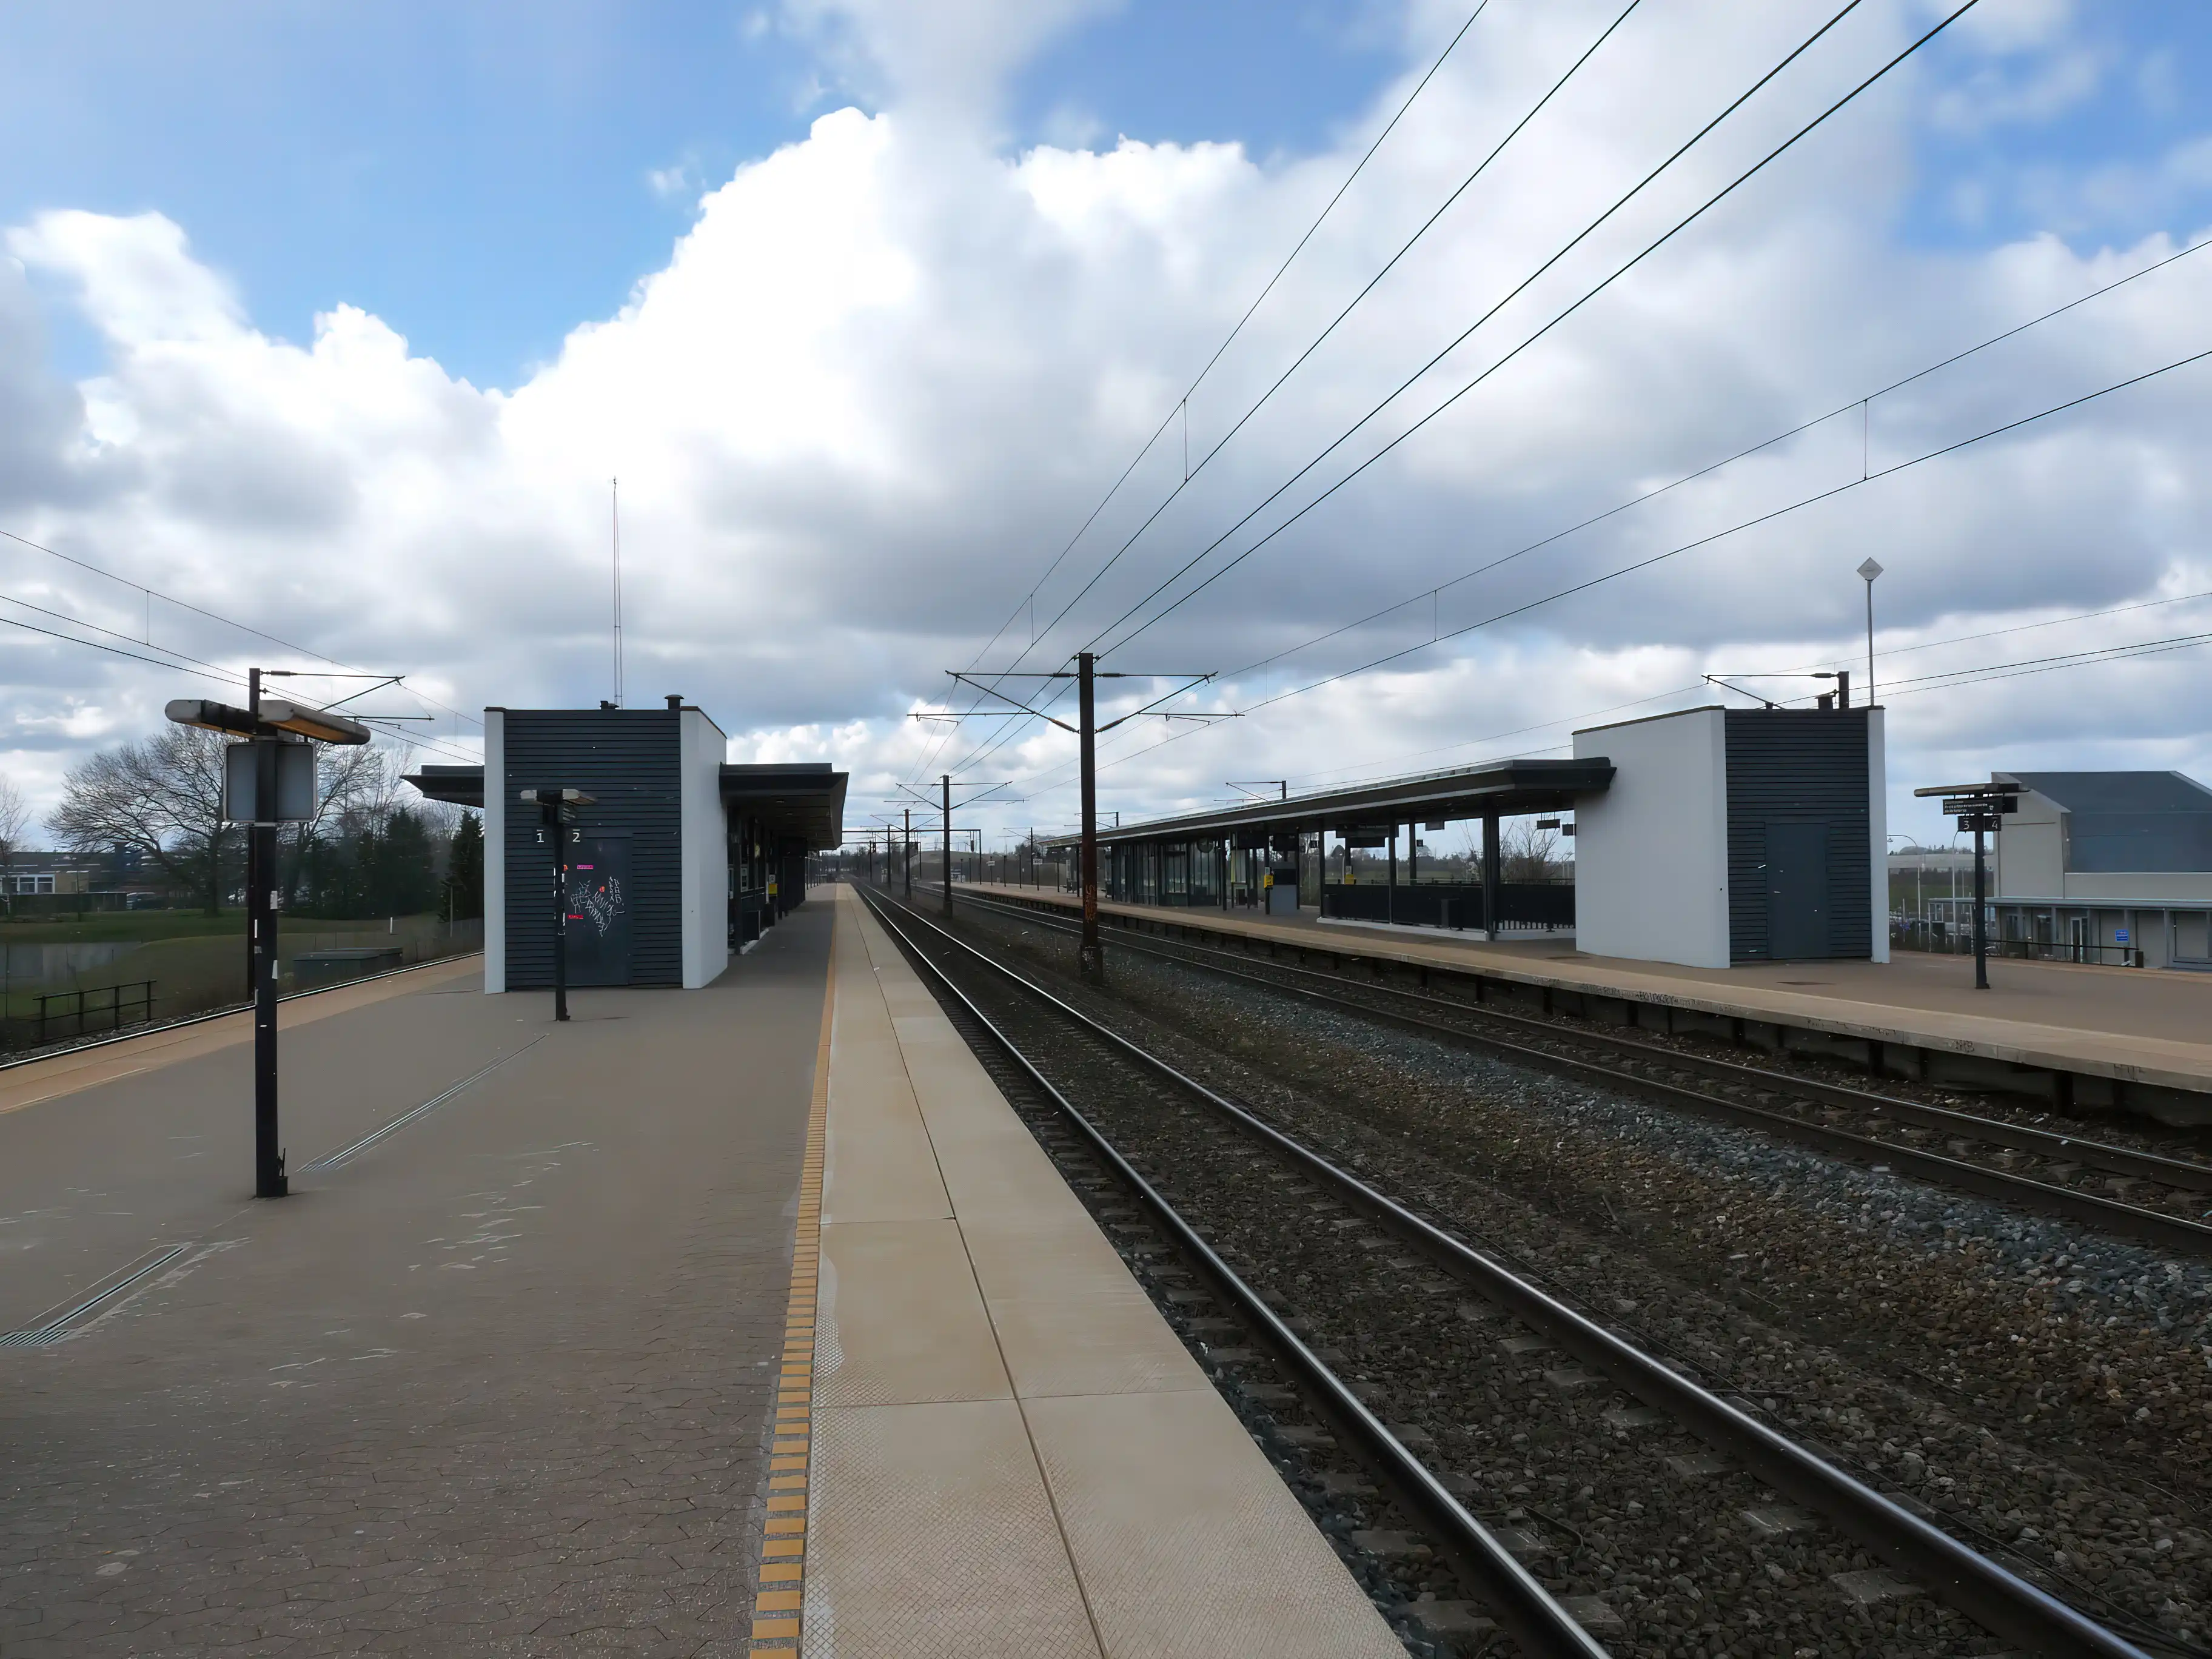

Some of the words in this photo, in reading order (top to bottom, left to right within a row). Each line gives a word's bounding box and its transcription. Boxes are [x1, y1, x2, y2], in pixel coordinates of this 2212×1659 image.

[1963, 820, 1969, 830] 3
[1991, 820, 1998, 829] 4
[537, 833, 545, 843] 1
[572, 832, 580, 842] 2
